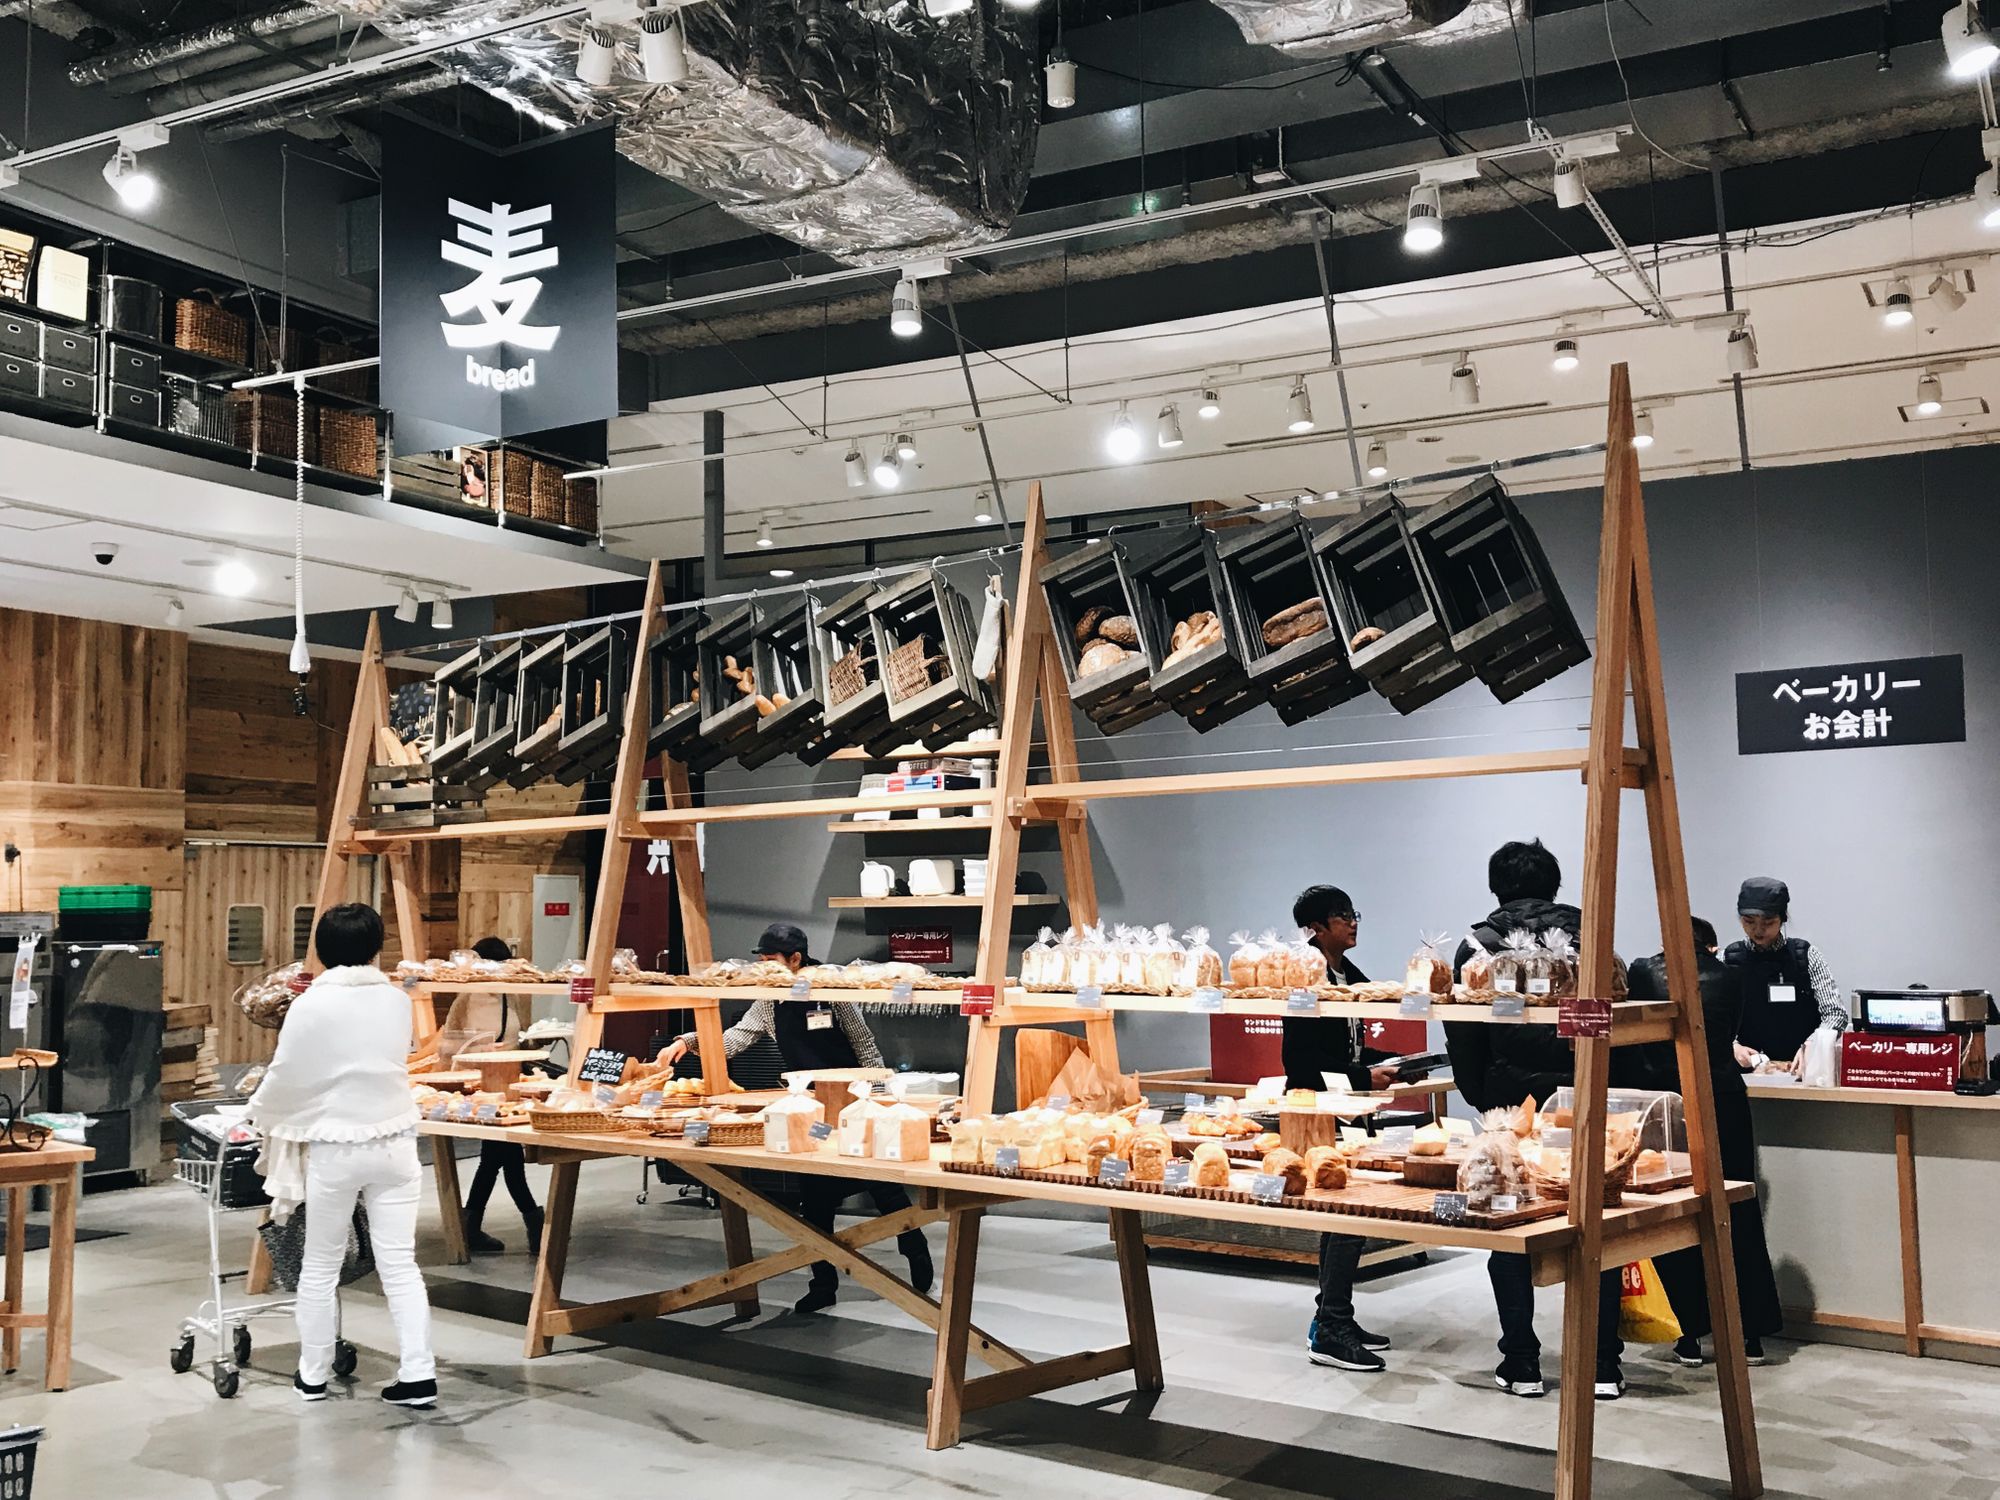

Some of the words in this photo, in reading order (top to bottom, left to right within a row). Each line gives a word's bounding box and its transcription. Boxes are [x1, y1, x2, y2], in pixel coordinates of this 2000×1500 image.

[439, 197, 561, 351] 麦
[466, 354, 536, 391] bread
[1772, 671, 1921, 704] ベーカリー
[1803, 707, 1893, 741] お会計
[1848, 1041, 1953, 1055] ベーカリー専用レジ
